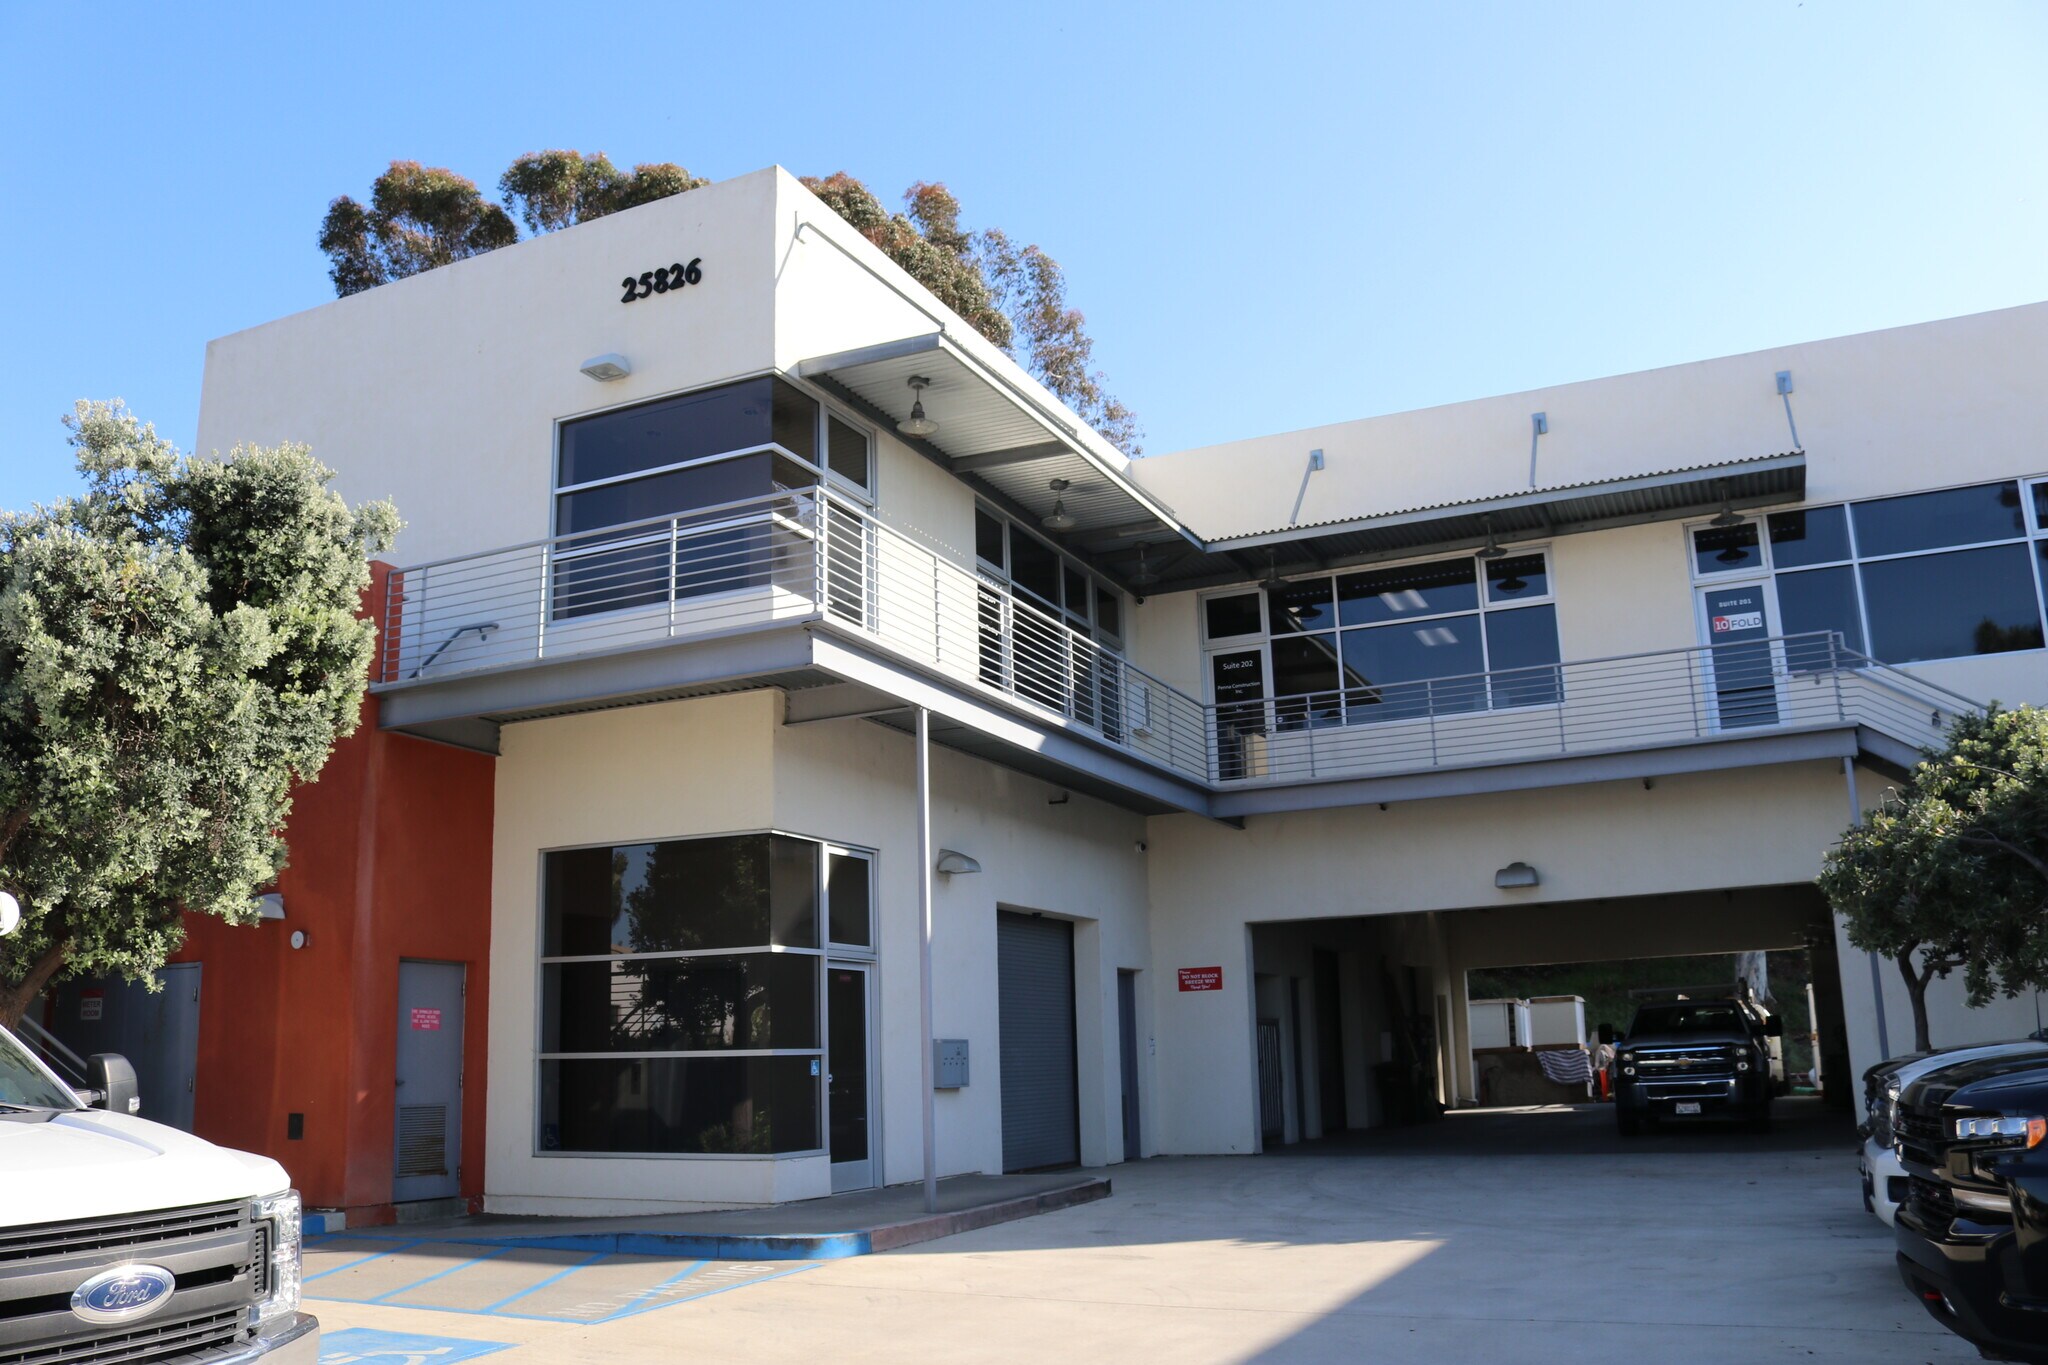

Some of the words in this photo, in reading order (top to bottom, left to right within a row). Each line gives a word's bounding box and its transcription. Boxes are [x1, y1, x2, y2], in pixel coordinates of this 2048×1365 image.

[621, 257, 702, 303] 25826
[1718, 600, 1738, 608] SUITE
[1715, 620, 1729, 631] 10
[1731, 617, 1762, 628] FOLD
[1222, 662, 1240, 670] Suite
[1240, 660, 1253, 668] 202
[1232, 681, 1260, 689] Construction
[103, 1279, 153, 1307] Ford
